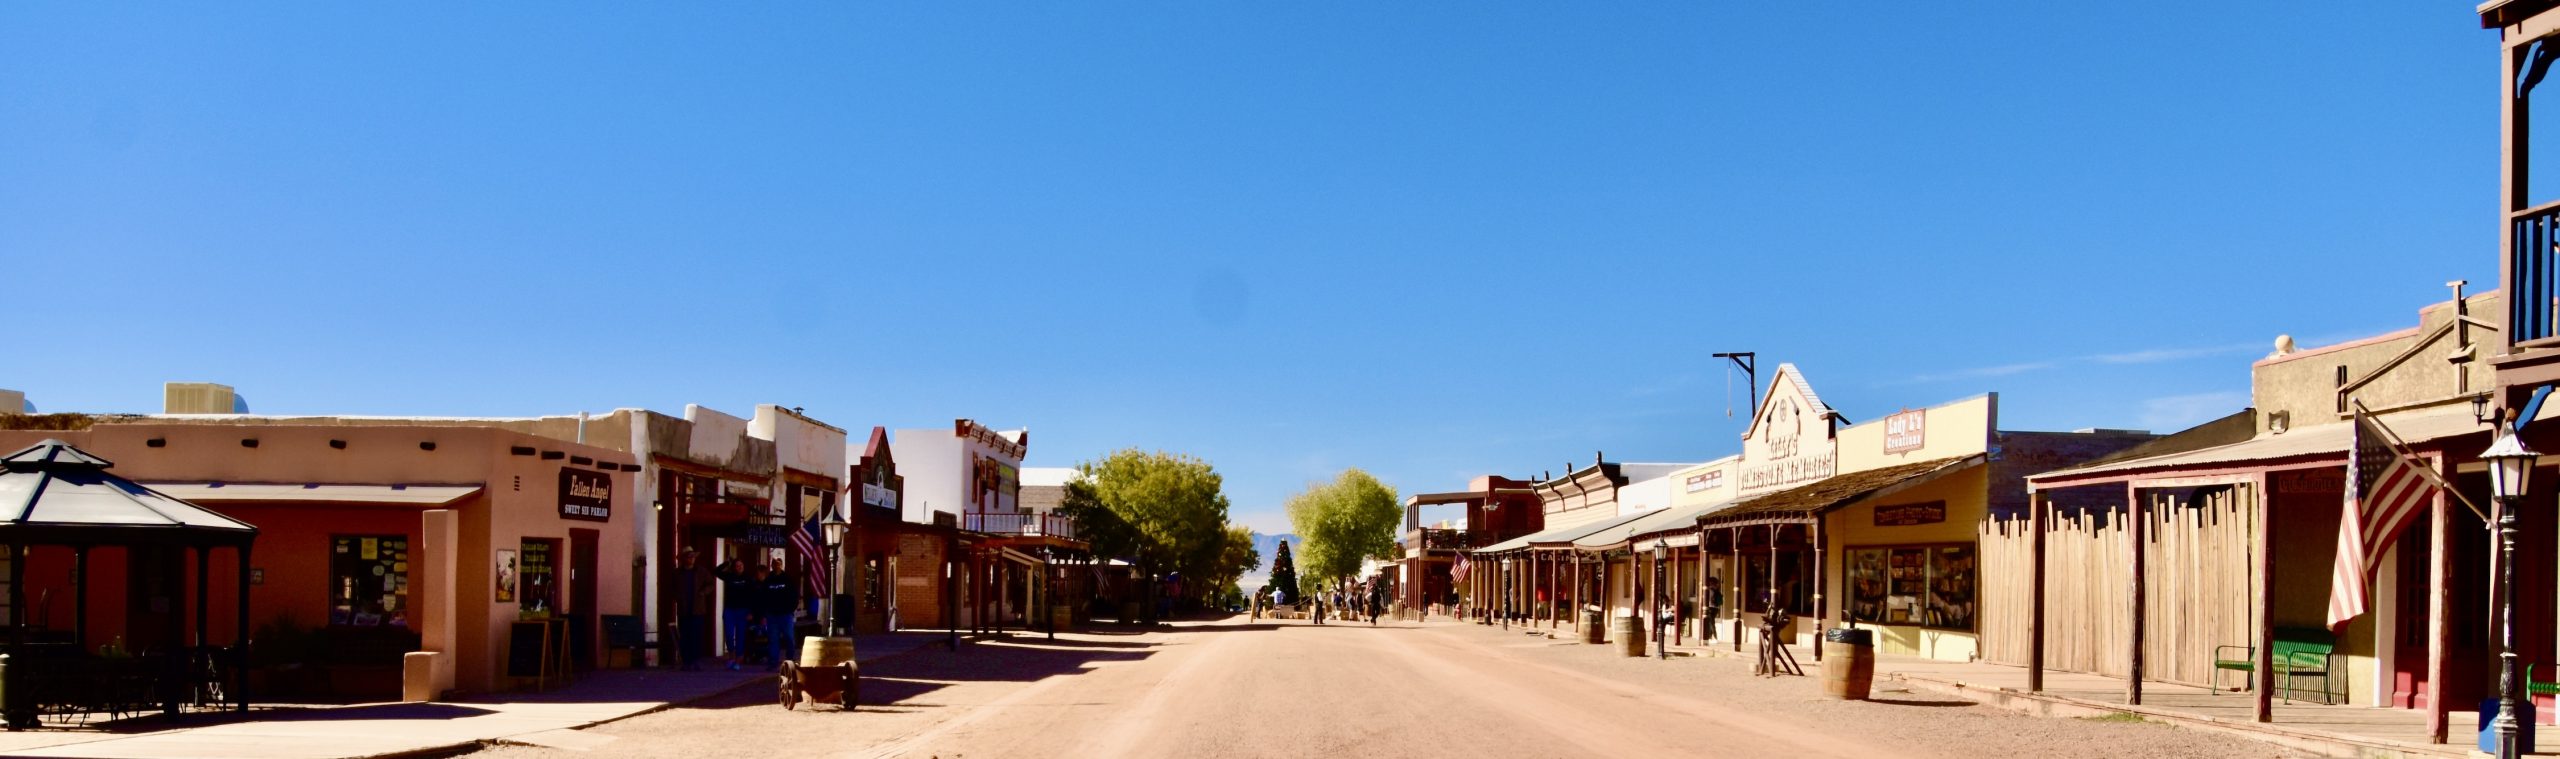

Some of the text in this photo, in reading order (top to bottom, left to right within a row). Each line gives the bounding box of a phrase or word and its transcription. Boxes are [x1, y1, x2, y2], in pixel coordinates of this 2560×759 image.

[1887, 435, 1921, 449] Creations
[570, 475, 609, 504] Fallen Angel
[565, 504, 581, 515] SWEET
[590, 507, 608, 517] PARLOR
